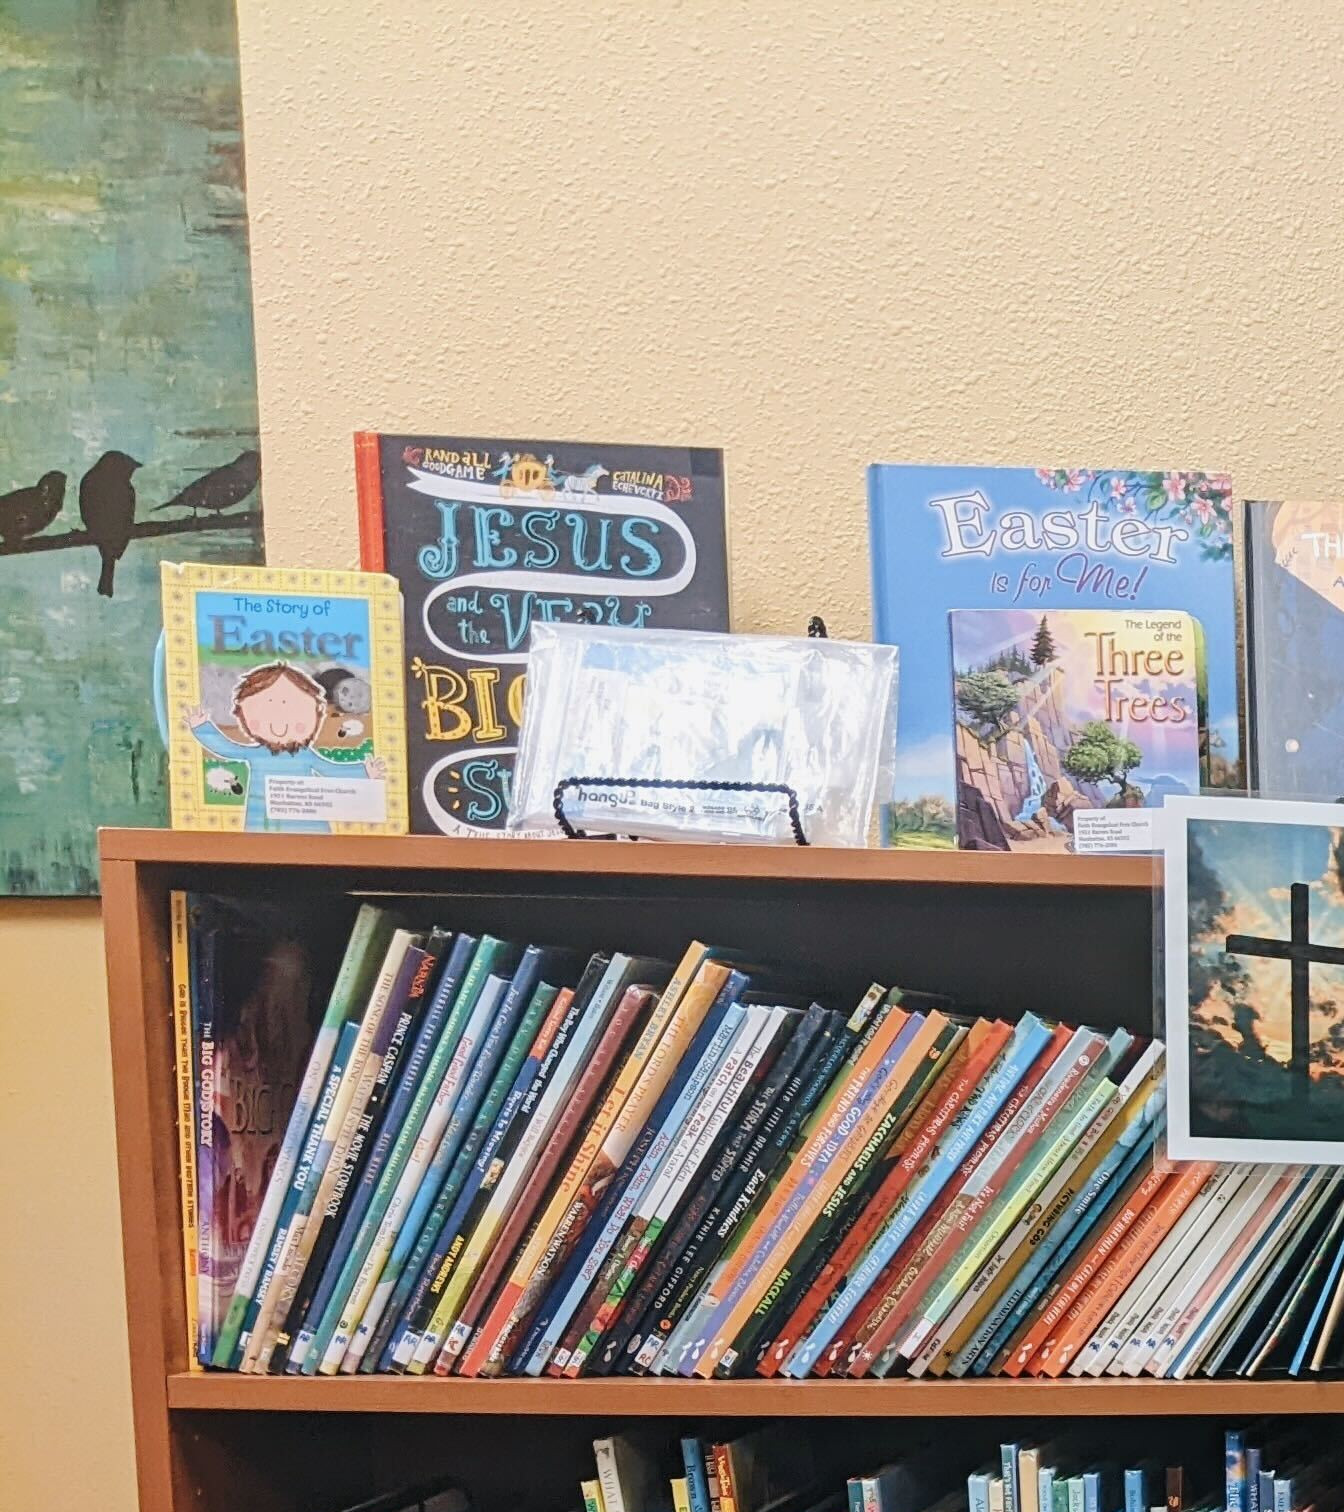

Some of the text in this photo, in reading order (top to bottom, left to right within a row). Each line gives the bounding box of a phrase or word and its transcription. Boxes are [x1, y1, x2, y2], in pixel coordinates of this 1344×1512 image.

[418, 500, 662, 580] JESUS
[929, 490, 1189, 564] Easter
[1013, 563, 1051, 603] for
[1056, 553, 1149, 601] Me!
[234, 597, 331, 619] The Story of
[446, 592, 483, 614] and
[1125, 619, 1181, 631] The Legend
[208, 615, 364, 660] Easter
[457, 619, 490, 644] the
[1154, 631, 1182, 642] of the
[1084, 631, 1185, 677] Three
[1094, 679, 1187, 723] Trees
[317, 1075, 341, 1119] SPECIAL
[294, 1164, 311, 1192] YOU
